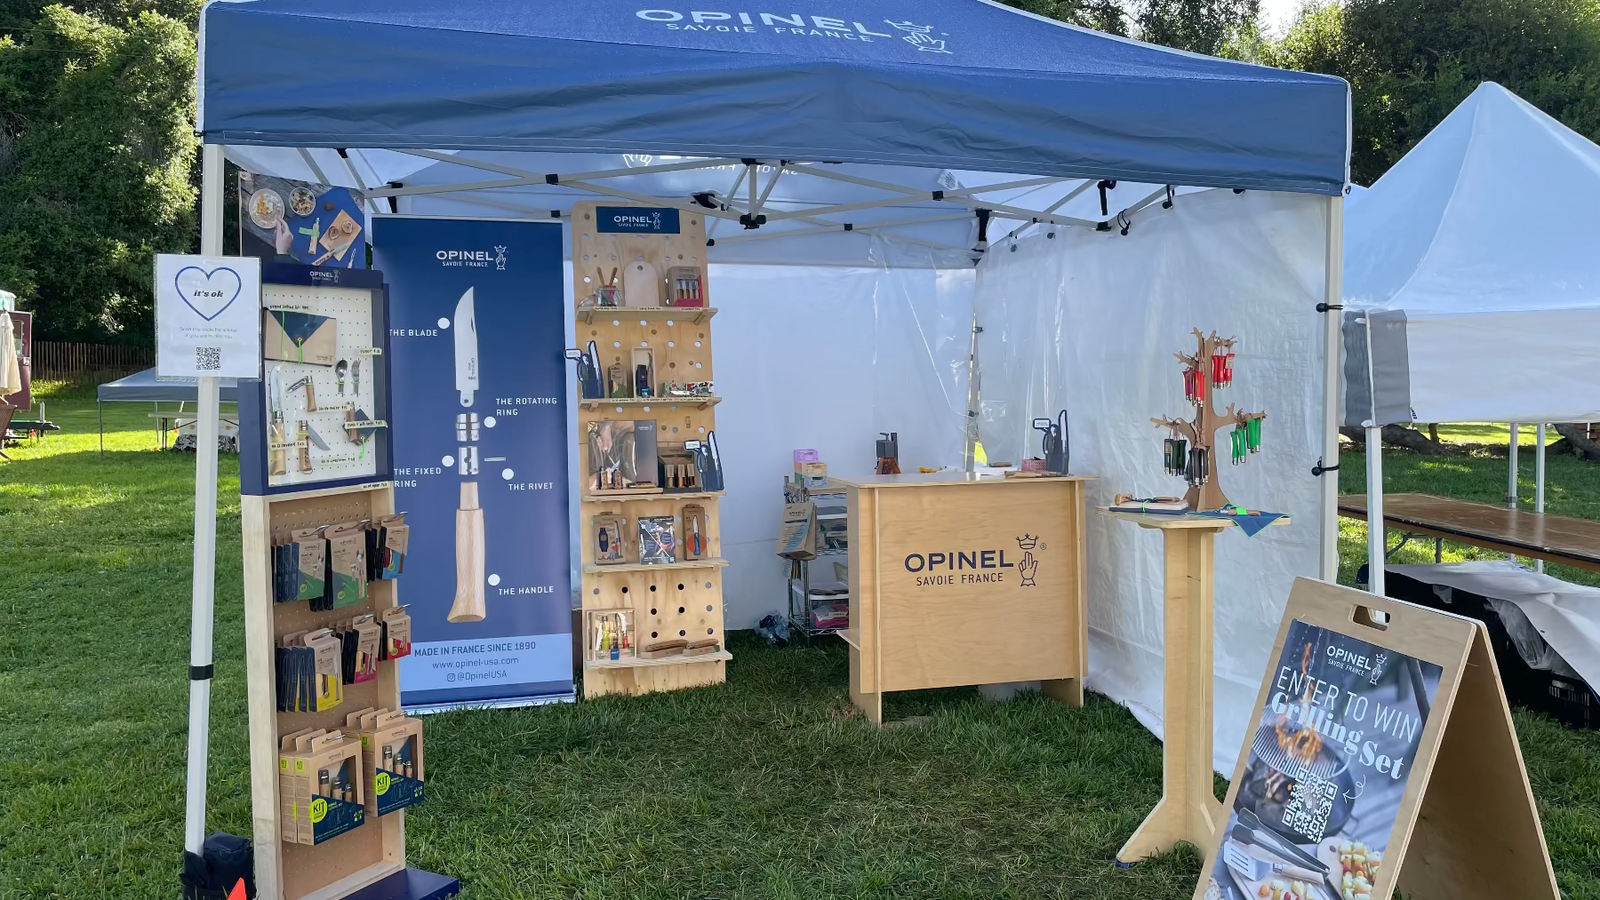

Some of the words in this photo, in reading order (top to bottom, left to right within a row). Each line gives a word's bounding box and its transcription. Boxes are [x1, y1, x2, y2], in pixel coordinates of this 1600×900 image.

[635, 9, 892, 38] OPINEL
[667, 23, 756, 33] SAVOIE
[774, 27, 874, 43] FRANCE
[613, 215, 652, 223] OPINEL
[436, 250, 494, 261] OPINEL
[193, 289, 210, 298] it's
[211, 290, 224, 298] ok
[389, 329, 405, 337] THE
[408, 329, 438, 337] BLADE
[496, 398, 513, 406] THE
[515, 397, 557, 406] ROTATING
[393, 467, 411, 476] THE
[414, 467, 442, 475] FIXED
[394, 480, 417, 488] RING
[508, 483, 526, 491] THE
[528, 482, 554, 490] RIVET
[904, 549, 1014, 573] OPINEL
[916, 575, 954, 586] SAVOIE
[961, 572, 1004, 584] FRANCE
[498, 588, 516, 596] THE
[518, 586, 554, 595] HANDLE
[414, 647, 438, 657] MADE
[440, 647, 450, 656] IN
[452, 644, 485, 655] FRANCE
[487, 643, 512, 653] SINCE
[514, 641, 536, 651] 1890
[432, 656, 519, 669] www.opinel-usa.com
[1326, 645, 1372, 671] OPINEL
[1327, 658, 1345, 670] SAVOIE
[1345, 663, 1365, 677] FRANCE
[457, 671, 508, 682] @OpinelUSA
[1276, 665, 1340, 711] ENTER
[1344, 691, 1369, 722] TO
[1373, 702, 1419, 744] WIN
[1271, 691, 1365, 755] Grilling
[1358, 740, 1405, 780] Set
[377, 775, 389, 787] KIT
[312, 801, 325, 814] KIT
